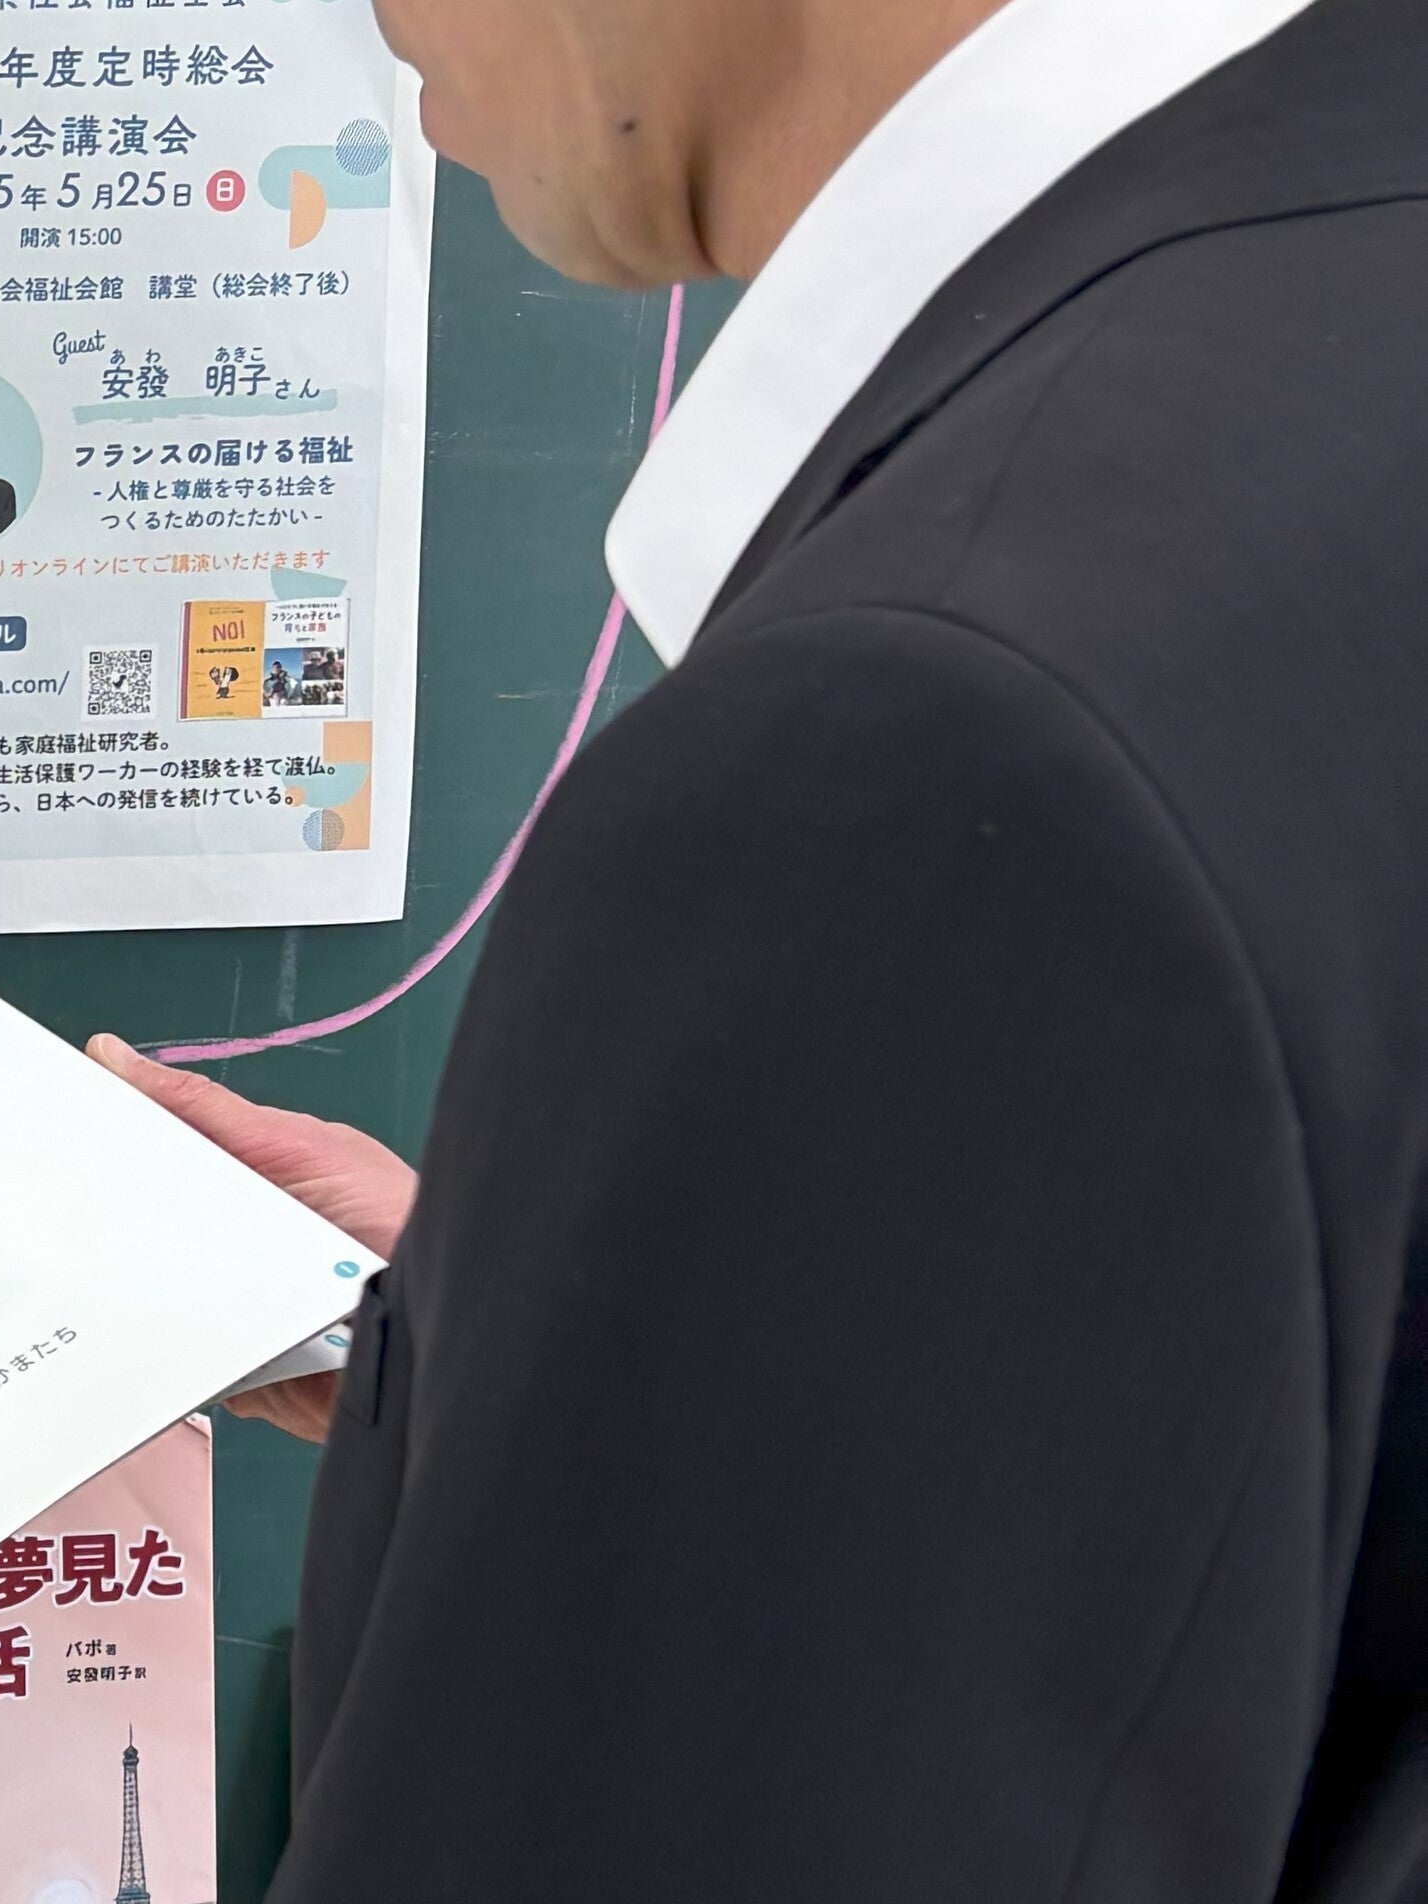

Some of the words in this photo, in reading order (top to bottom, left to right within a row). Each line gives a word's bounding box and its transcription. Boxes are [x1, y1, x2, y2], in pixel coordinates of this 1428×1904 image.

[216, 177, 237, 202] 日
[20, 226, 62, 249] 開演
[66, 225, 123, 247] 15:00
[52, 328, 107, 365] Guest
[215, 346, 265, 364] あきこ
[102, 363, 170, 400] 安發
[75, 435, 354, 468] フランスの届ける福祉
